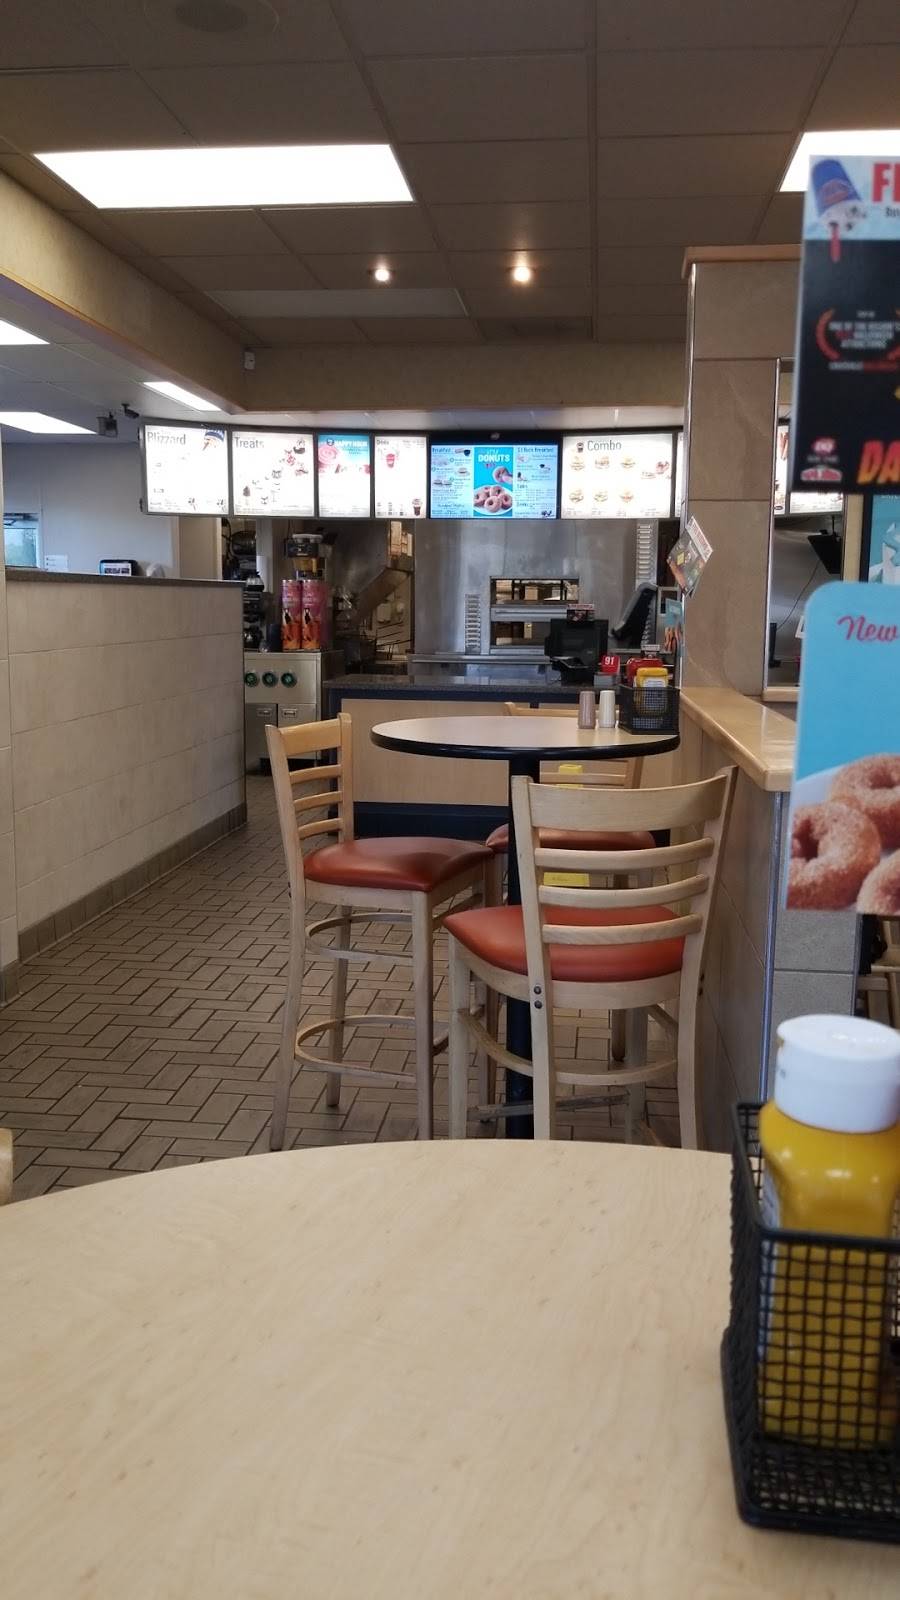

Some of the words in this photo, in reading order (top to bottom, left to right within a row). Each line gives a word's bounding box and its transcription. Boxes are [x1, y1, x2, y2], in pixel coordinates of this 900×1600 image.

[147, 431, 186, 446] Blizzard
[234, 436, 265, 449] Treats
[587, 440, 622, 451] Combo
[477, 454, 511, 463] DONUTS
[837, 614, 898, 643] New
[605, 656, 615, 665] 91
